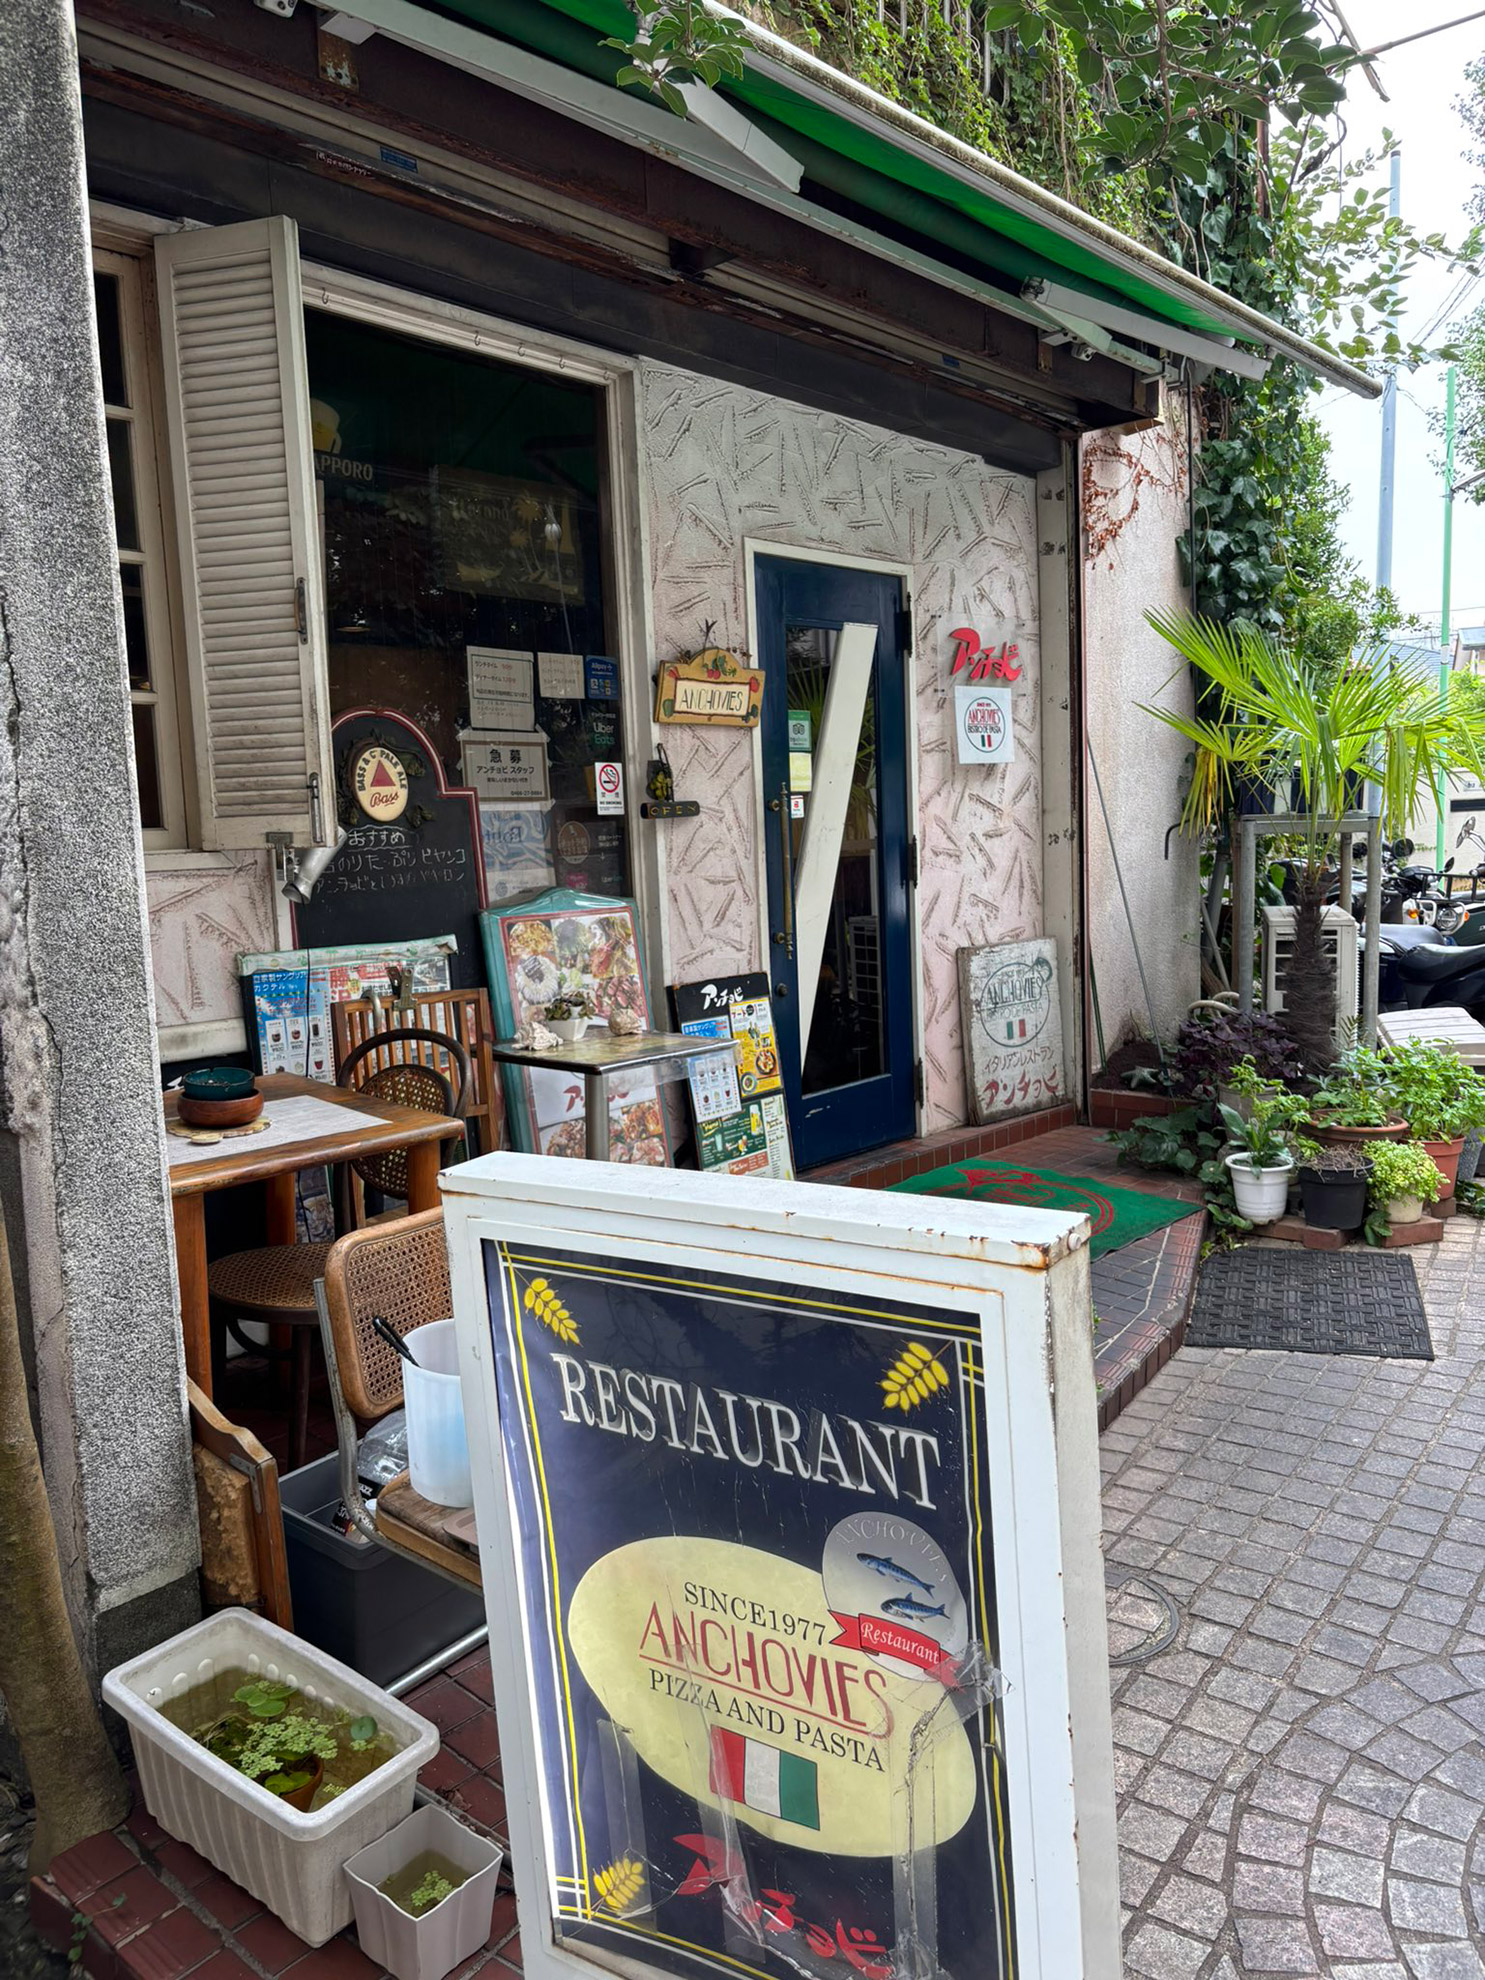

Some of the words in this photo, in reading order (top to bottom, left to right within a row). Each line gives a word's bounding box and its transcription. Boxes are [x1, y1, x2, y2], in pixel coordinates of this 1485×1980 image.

[314, 455, 373, 481] APPORO
[681, 688, 743, 712] ANCHOVIES
[593, 722, 614, 734] Uber
[595, 734, 615, 745] Eats
[356, 766, 367, 792] BASS
[380, 750, 400, 769] PALE
[397, 771, 407, 789] ALE
[370, 791, 399, 808] Bass
[348, 830, 406, 847] おすすめ
[984, 1047, 1054, 1074] イタリアンレストラン
[982, 1064, 1060, 1110] アンチョビ
[550, 1352, 941, 1511] RESTAURANT
[684, 1581, 826, 1646] SINCE1977
[860, 1621, 940, 1665] Restaurant
[639, 1601, 895, 1740] ANCHOVIES
[649, 1667, 722, 1714] PIZZA
[728, 1699, 786, 1736] AND
[794, 1717, 886, 1774] PASTA
